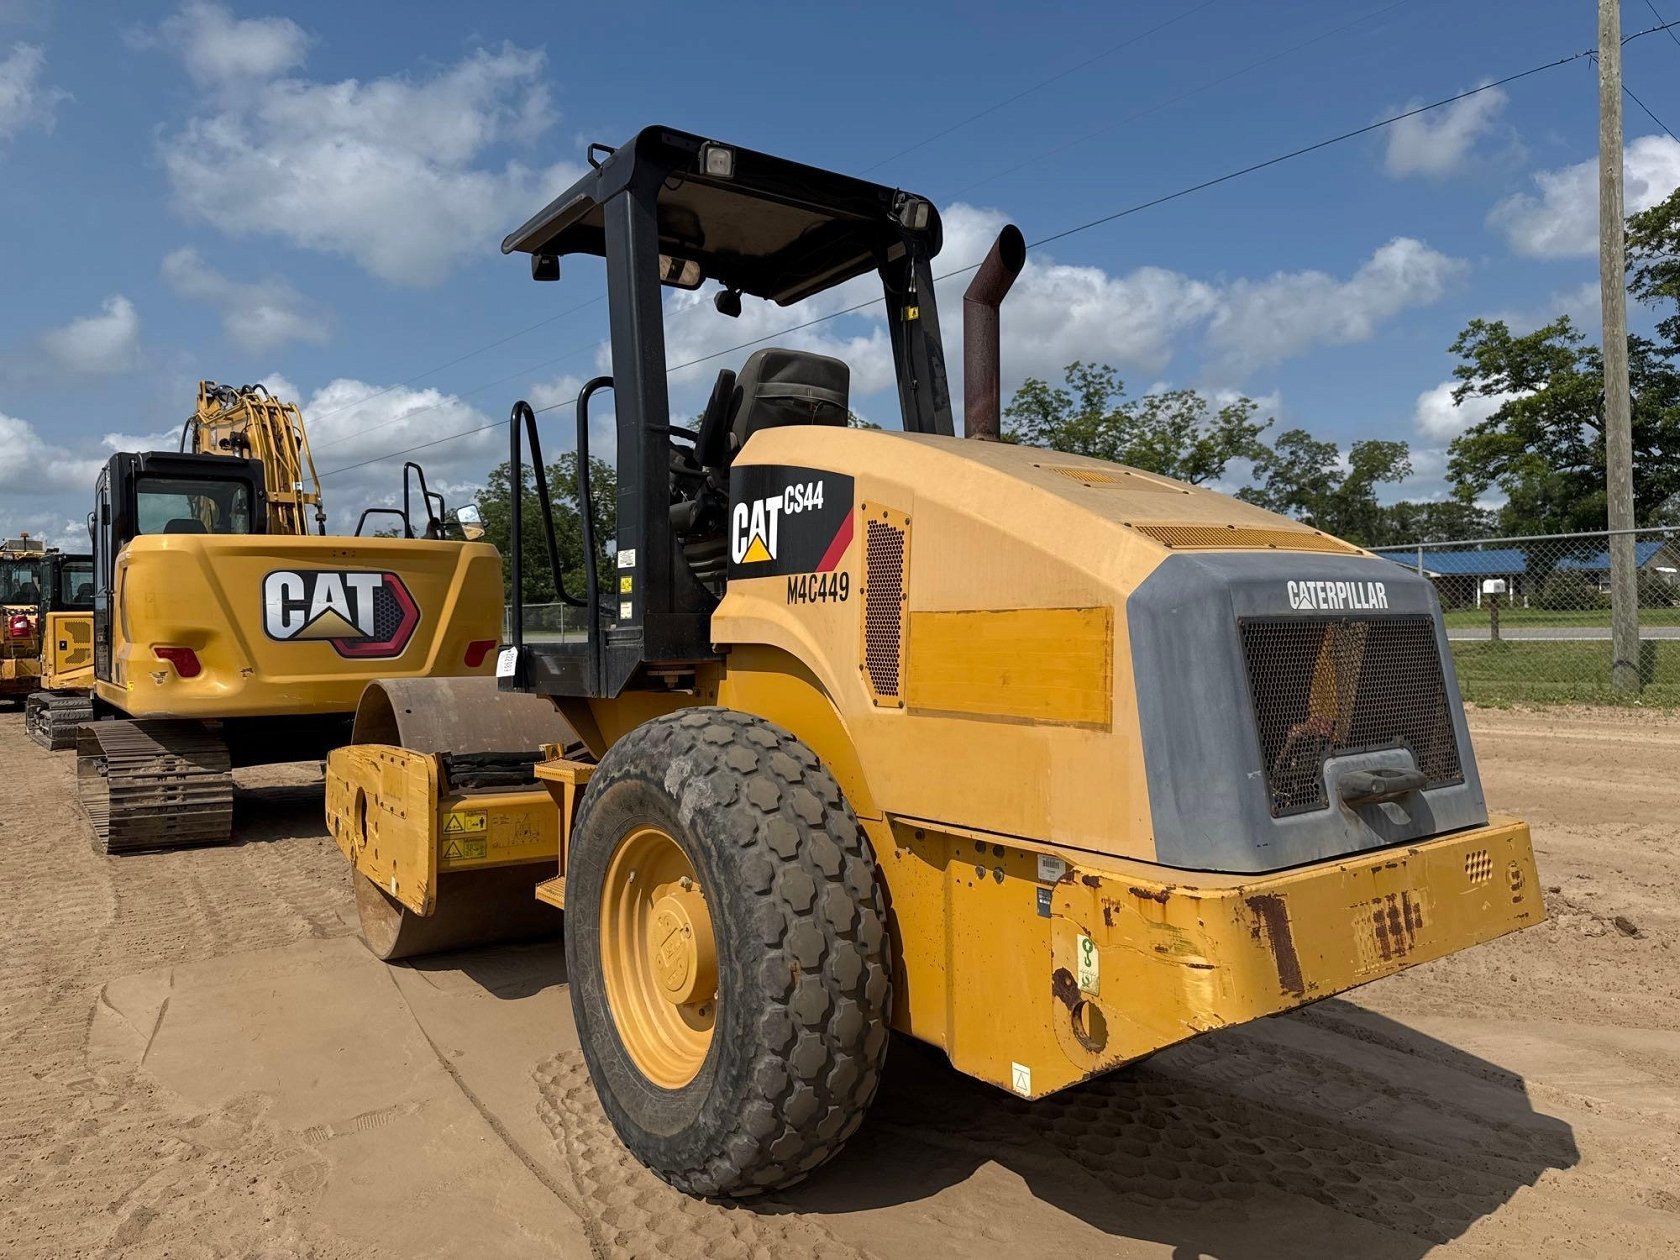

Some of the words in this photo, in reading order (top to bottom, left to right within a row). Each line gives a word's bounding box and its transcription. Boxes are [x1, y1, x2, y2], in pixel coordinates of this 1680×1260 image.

[732, 495, 783, 565] CAT
[784, 480, 824, 515] CS44
[265, 571, 383, 639] CAT
[787, 571, 850, 605] M4C449
[1287, 580, 1389, 610] CATERPILLAR
